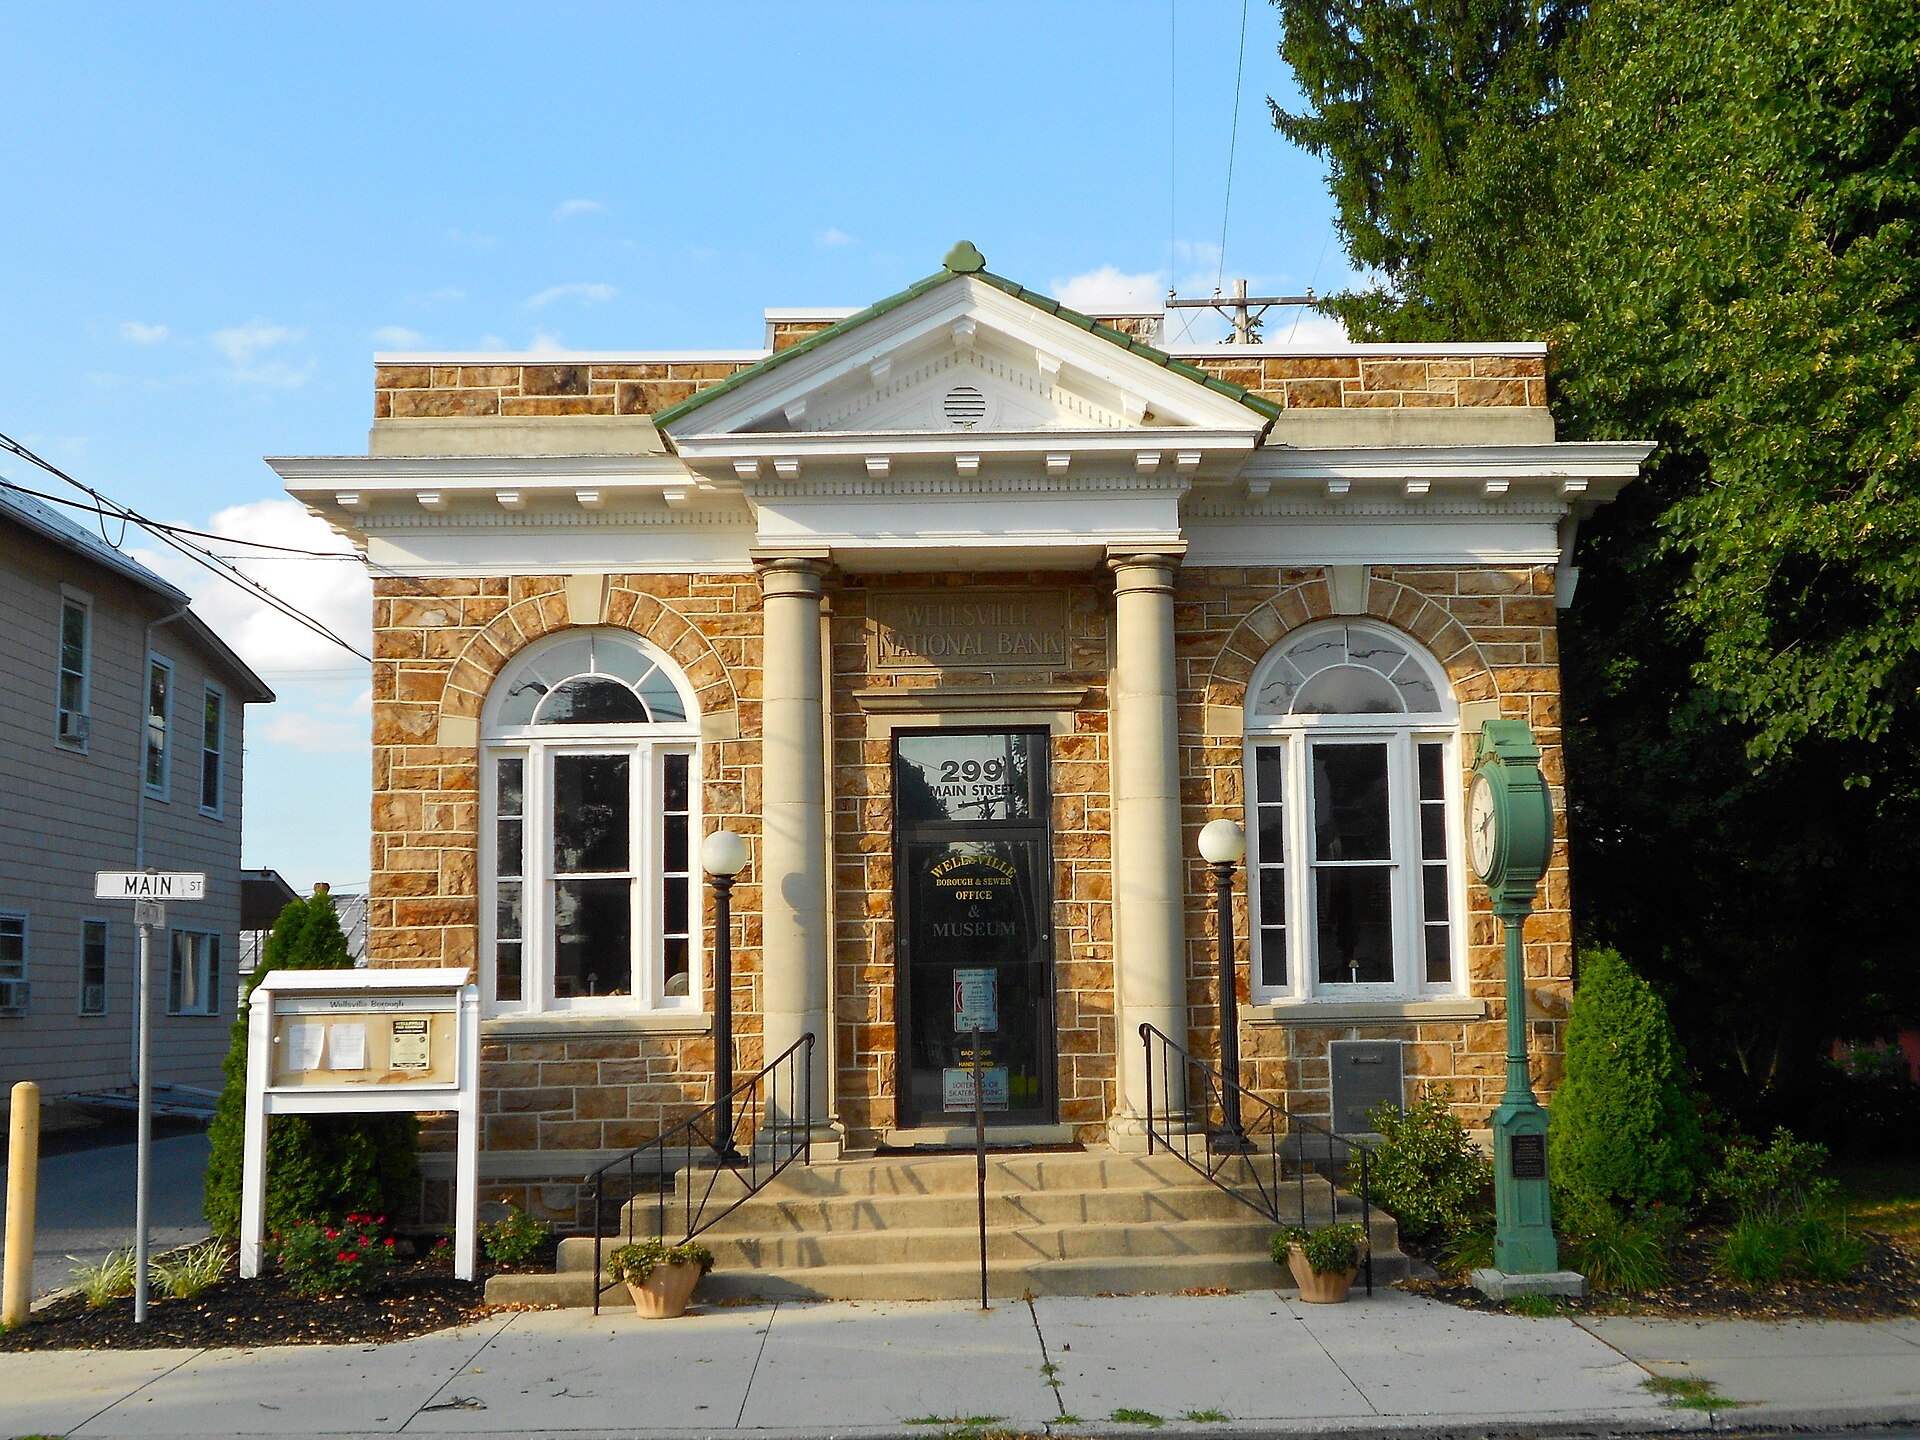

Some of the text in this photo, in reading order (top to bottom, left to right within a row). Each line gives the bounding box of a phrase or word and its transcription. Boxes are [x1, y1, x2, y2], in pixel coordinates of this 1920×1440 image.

[904, 603, 1034, 627] WELLSVILLE
[878, 631, 1062, 657] NATIONAL BANK
[940, 759, 1003, 782] 299
[929, 784, 1016, 797] MAIN STREET
[930, 855, 1017, 878] WELLSVILLE
[124, 876, 202, 895] MAIN ST
[936, 878, 973, 887] BOROUGH
[982, 878, 1012, 886] SEWER
[955, 890, 993, 900] OFFICE
[968, 904, 980, 918] &
[932, 921, 1016, 937] MUSEUM
[370, 999, 404, 1009] Borough
